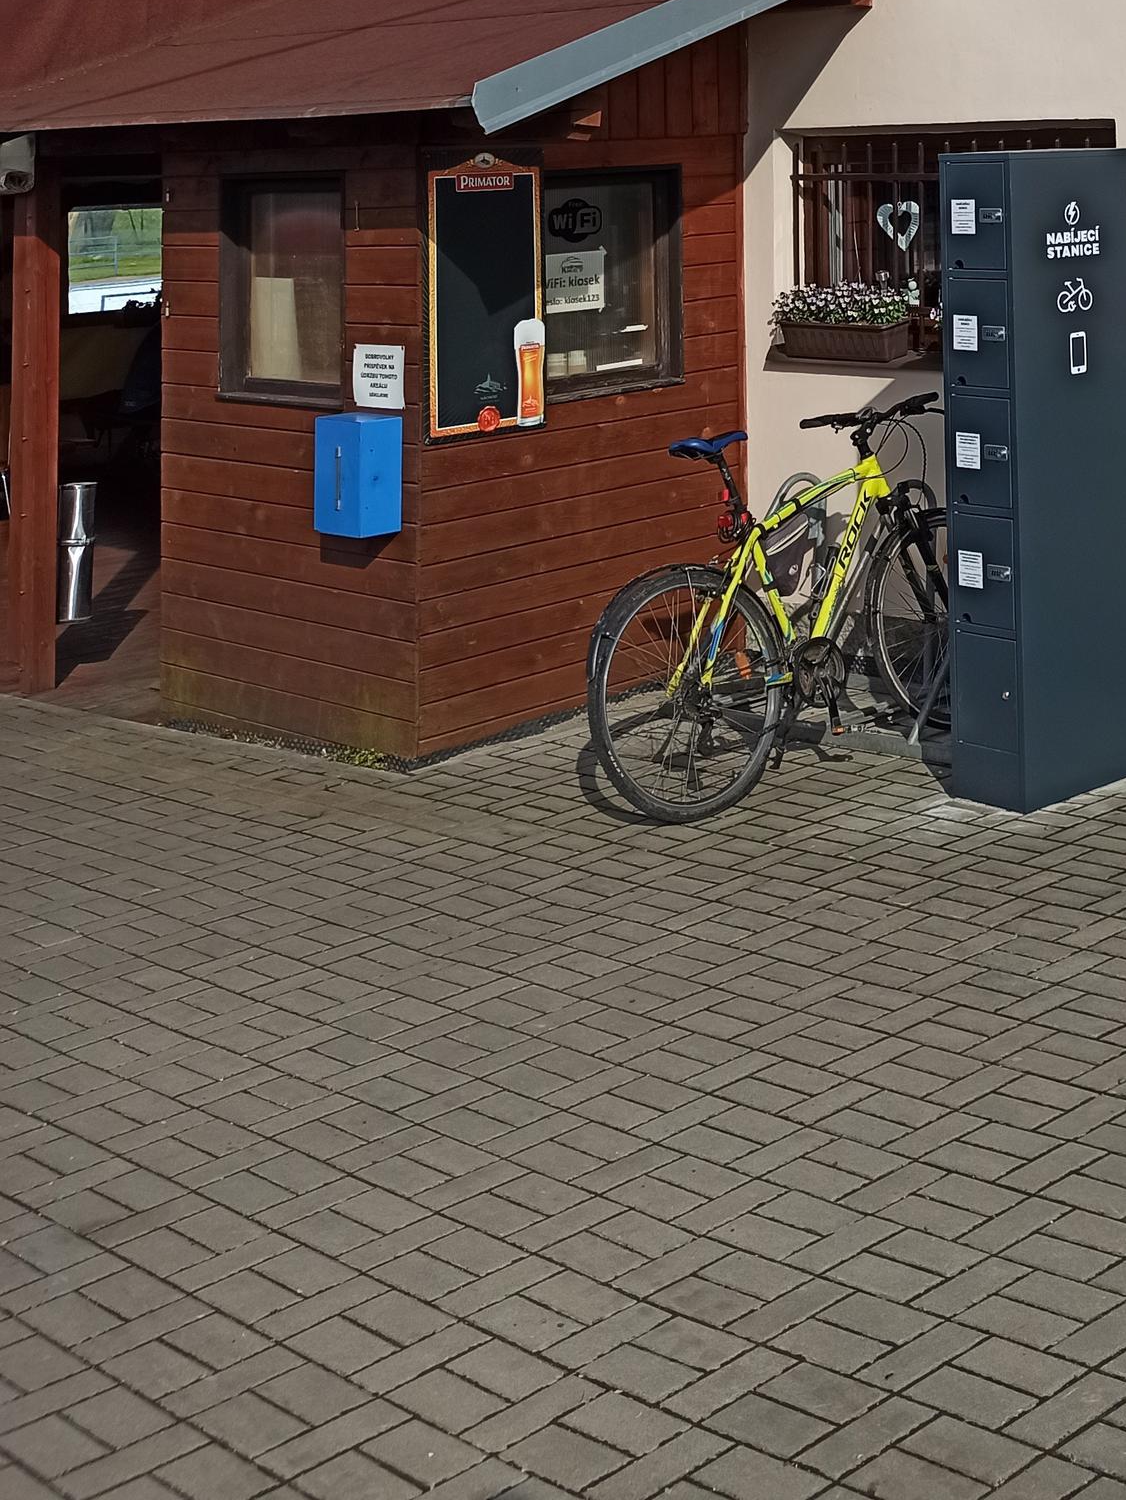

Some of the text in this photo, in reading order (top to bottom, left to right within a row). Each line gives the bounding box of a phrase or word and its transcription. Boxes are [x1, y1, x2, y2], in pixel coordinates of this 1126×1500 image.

[460, 175, 510, 189] PRIMATOR
[1046, 225, 1100, 245] NABÍJECÍ
[1046, 243, 1100, 259] STANICE
[568, 274, 600, 288] kiosek
[838, 489, 871, 570] ROCK
